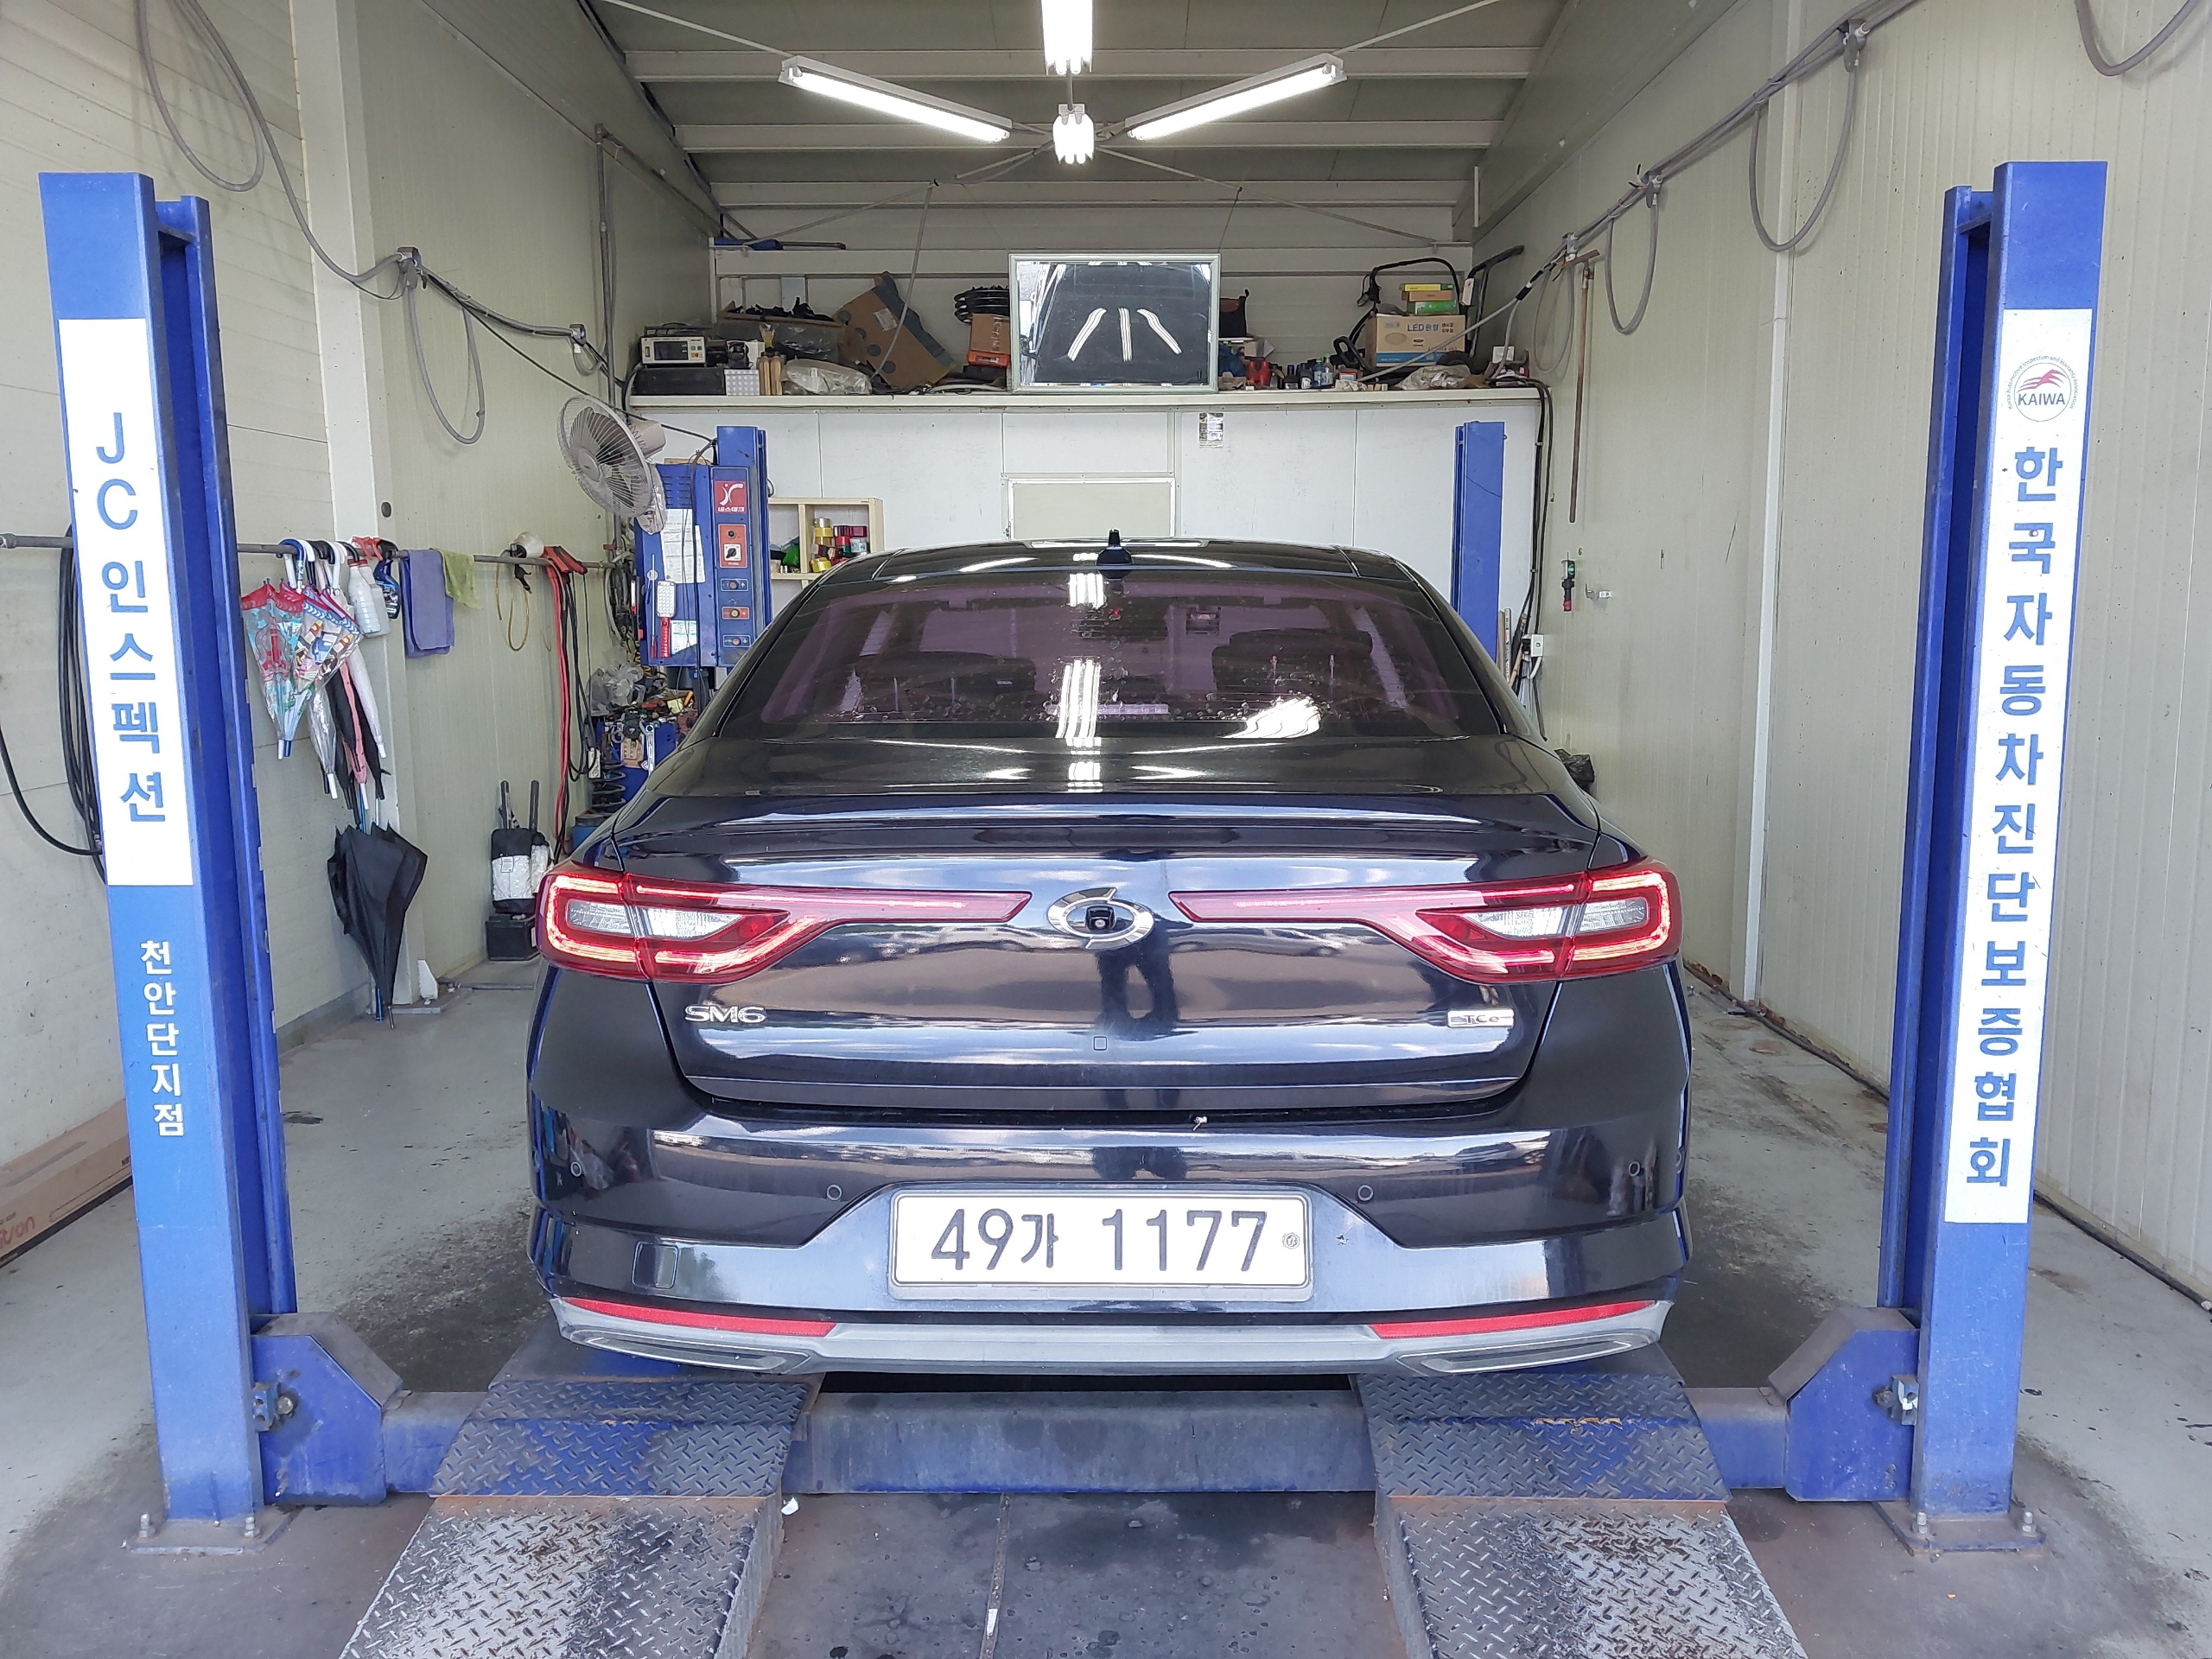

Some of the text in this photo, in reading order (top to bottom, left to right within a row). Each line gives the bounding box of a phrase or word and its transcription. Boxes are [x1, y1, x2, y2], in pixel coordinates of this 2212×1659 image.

[2018, 392, 2066, 406] KAIWA
[2022, 355, 2050, 367] Inspection
[2059, 359, 2076, 379] Warranty
[2069, 378, 2079, 410] Association
[683, 1004, 766, 1024] SM6
[1462, 1014, 1500, 1025] TCe
[139, 938, 186, 1138] 천안단지점
[931, 1208, 1268, 1272] 49가 1177
